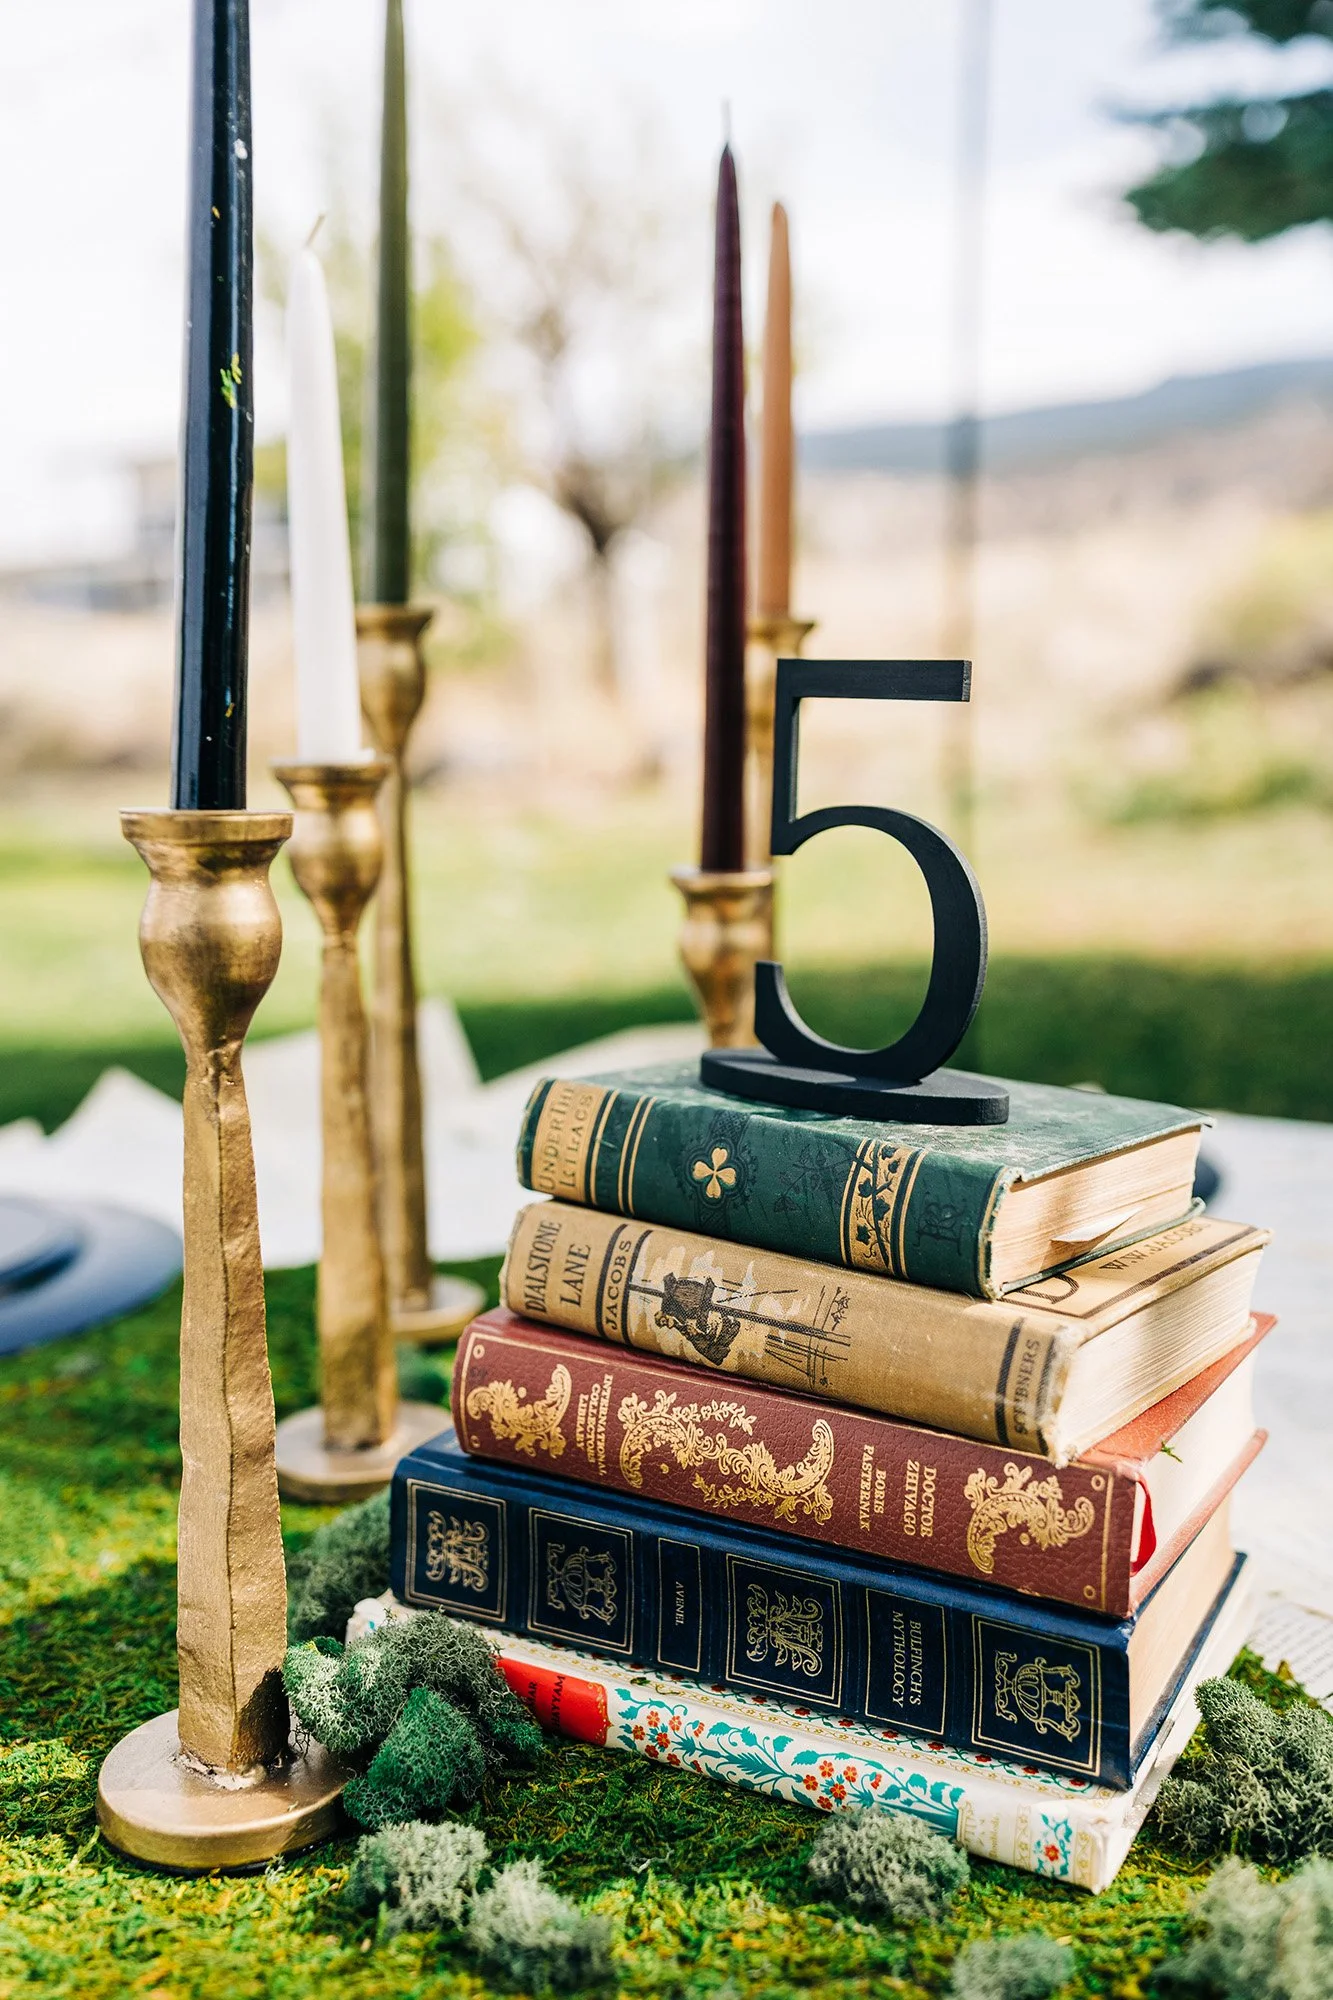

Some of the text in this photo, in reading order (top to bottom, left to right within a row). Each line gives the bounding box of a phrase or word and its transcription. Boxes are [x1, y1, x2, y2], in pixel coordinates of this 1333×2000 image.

[753, 658, 989, 1085] 5
[538, 1118, 563, 1191] UNDER
[559, 1093, 593, 1188] LILACS
[523, 1219, 562, 1314] DIALSTONE
[560, 1243, 591, 1308] LANE
[605, 1240, 632, 1331] JACOBS
[576, 1393, 590, 1452] LIBRARY
[586, 1383, 601, 1463] COLLECTORS
[596, 1373, 614, 1476] INTERNATIONAL
[859, 1444, 875, 1532] PASTERNAK
[873, 1468, 888, 1515] BORIS
[903, 1458, 921, 1536] ZHIVAGO
[920, 1465, 938, 1538] DOCTOR
[675, 1581, 685, 1626] AVENEL
[892, 1610, 906, 1708] MYTHOLOGY
[909, 1620, 923, 1706] BULFINCH'S
[551, 1675, 566, 1729] HAYYAM
